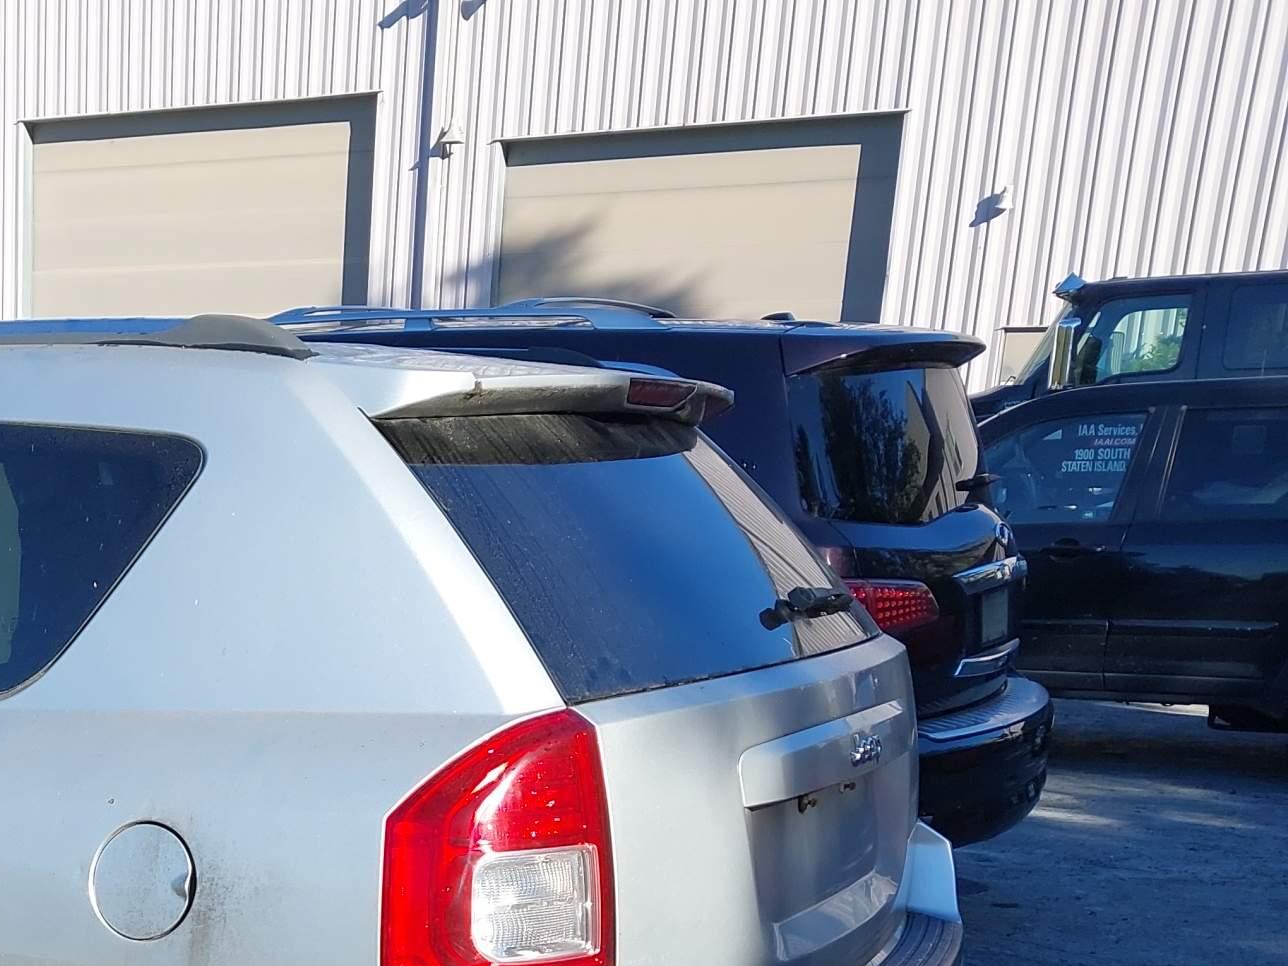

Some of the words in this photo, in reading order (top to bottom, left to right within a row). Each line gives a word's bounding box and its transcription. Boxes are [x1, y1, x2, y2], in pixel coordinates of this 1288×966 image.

[1078, 423, 1095, 436] IAA
[1074, 448, 1095, 460] 1900
[1097, 447, 1131, 460] SOUTH
[1061, 460, 1092, 473] STATEN
